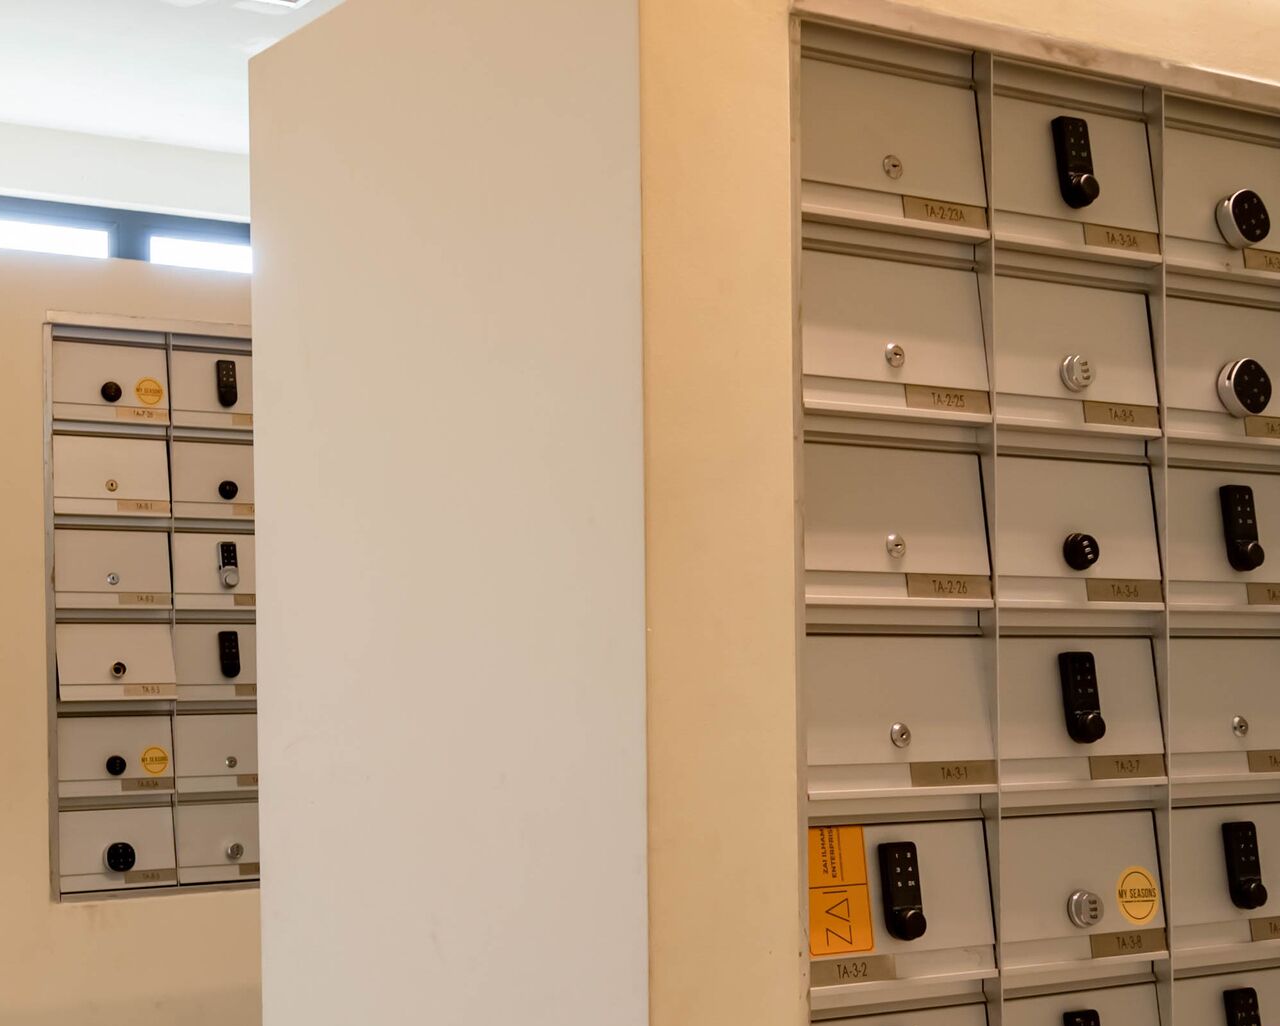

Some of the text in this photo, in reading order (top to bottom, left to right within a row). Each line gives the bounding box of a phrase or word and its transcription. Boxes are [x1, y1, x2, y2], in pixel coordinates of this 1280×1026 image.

[925, 204, 964, 221] TA-2-23A
[1106, 232, 1137, 247] TA-3-3A
[931, 392, 965, 408] TA-2-25
[1108, 408, 1135, 423] TA-3-5
[932, 579, 967, 594] TA-2-26
[1111, 584, 1139, 598] TA-3-6
[941, 767, 968, 781] TA-3-1
[1115, 760, 1140, 773] TA-3-7
[828, 829, 837, 878] ENTERPRIS
[1118, 888, 1157, 898] MY SEASONS
[1116, 935, 1142, 950] TA-3-8
[837, 962, 867, 979] TA-3-2
